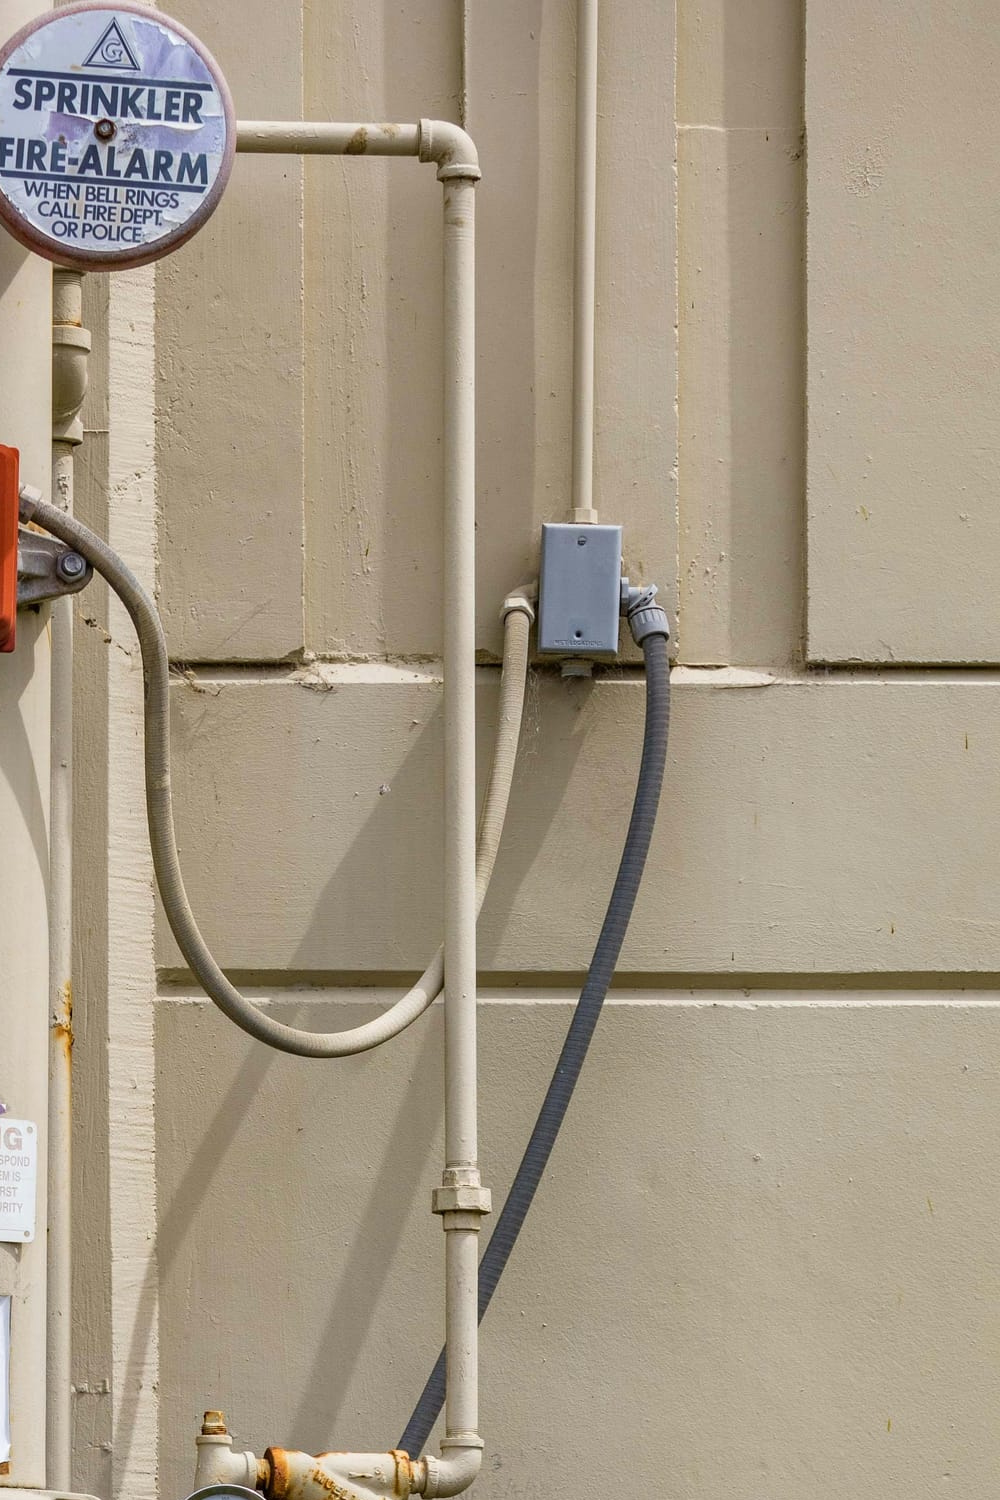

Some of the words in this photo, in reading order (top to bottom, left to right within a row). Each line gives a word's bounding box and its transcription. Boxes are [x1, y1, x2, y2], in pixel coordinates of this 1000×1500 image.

[100, 36, 123, 63] G
[12, 78, 204, 124] SPRINKLER
[23, 180, 81, 201] WHEN
[84, 186, 121, 204] BELL
[124, 188, 180, 209] RINGS
[37, 201, 80, 220] CALL
[83, 205, 117, 222] FIRE
[120, 208, 163, 227] DEPT.
[51, 220, 78, 239] OR
[81, 223, 142, 243] POLICE
[12, 1171, 21, 1182] IS
